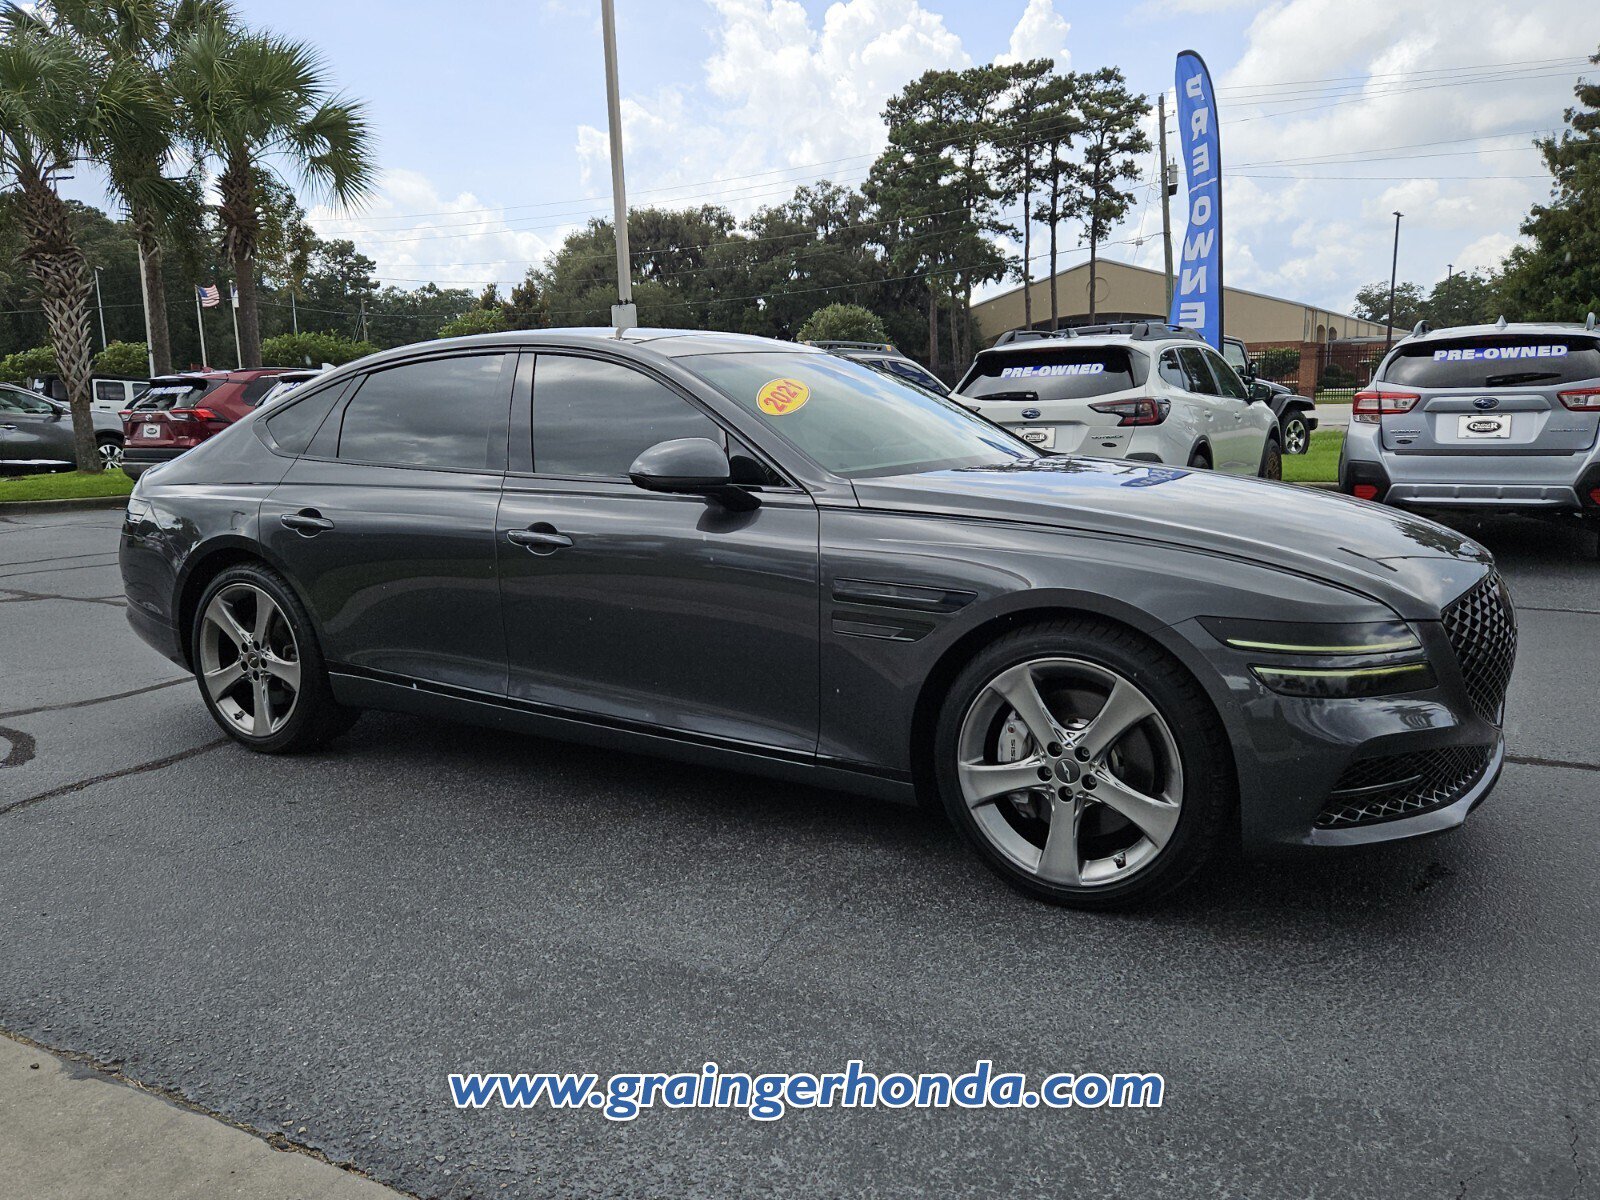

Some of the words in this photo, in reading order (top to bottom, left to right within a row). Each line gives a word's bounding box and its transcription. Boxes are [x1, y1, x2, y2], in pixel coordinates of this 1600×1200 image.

[1433, 345, 1568, 361] PRE-OWNED
[1000, 363, 1104, 379] PRE-OWNED
[763, 380, 803, 412] 2021
